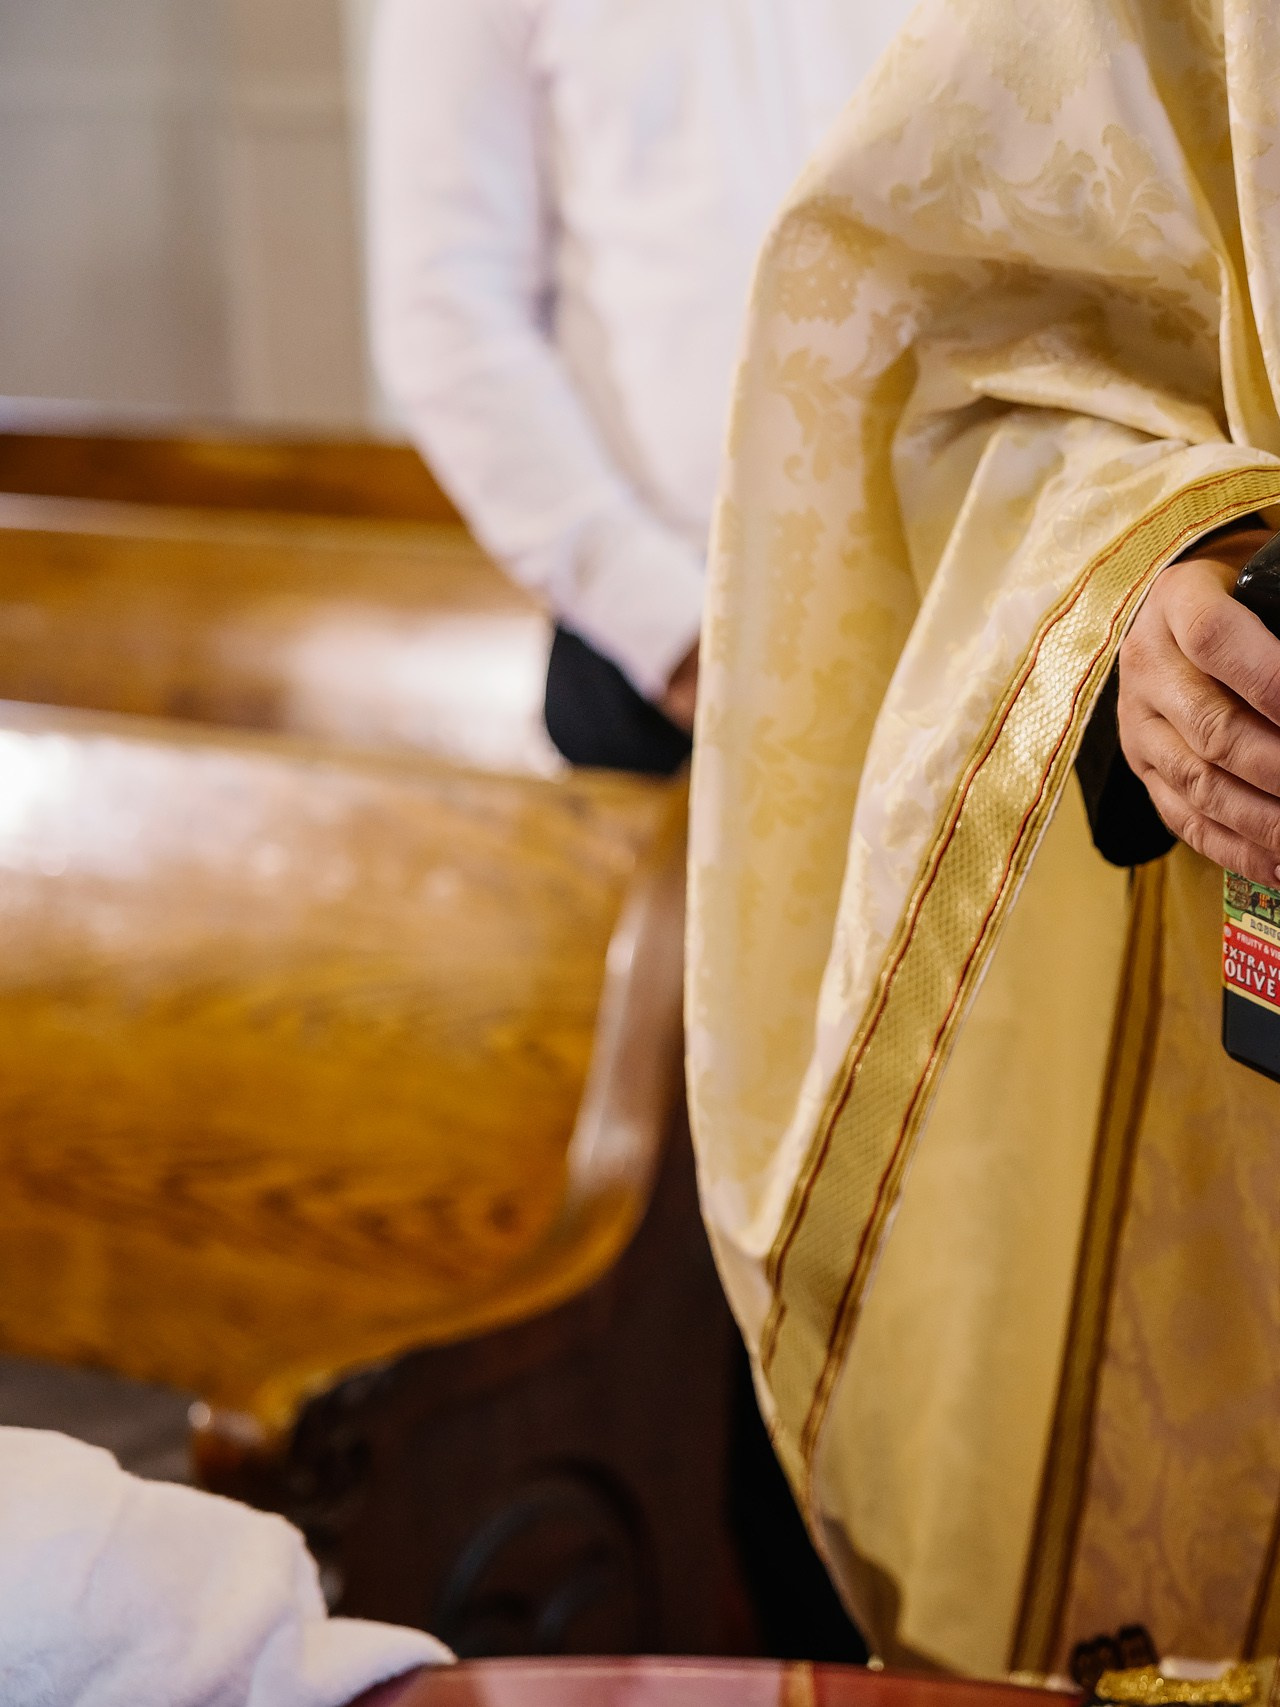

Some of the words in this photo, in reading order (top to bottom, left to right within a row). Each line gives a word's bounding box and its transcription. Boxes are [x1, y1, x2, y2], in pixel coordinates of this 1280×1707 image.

[1223, 941, 1266, 974] EXTRA
[1236, 932, 1262, 951] FRUITY
[1263, 945, 1269, 954] &
[1224, 958, 1276, 997] OLIVE
